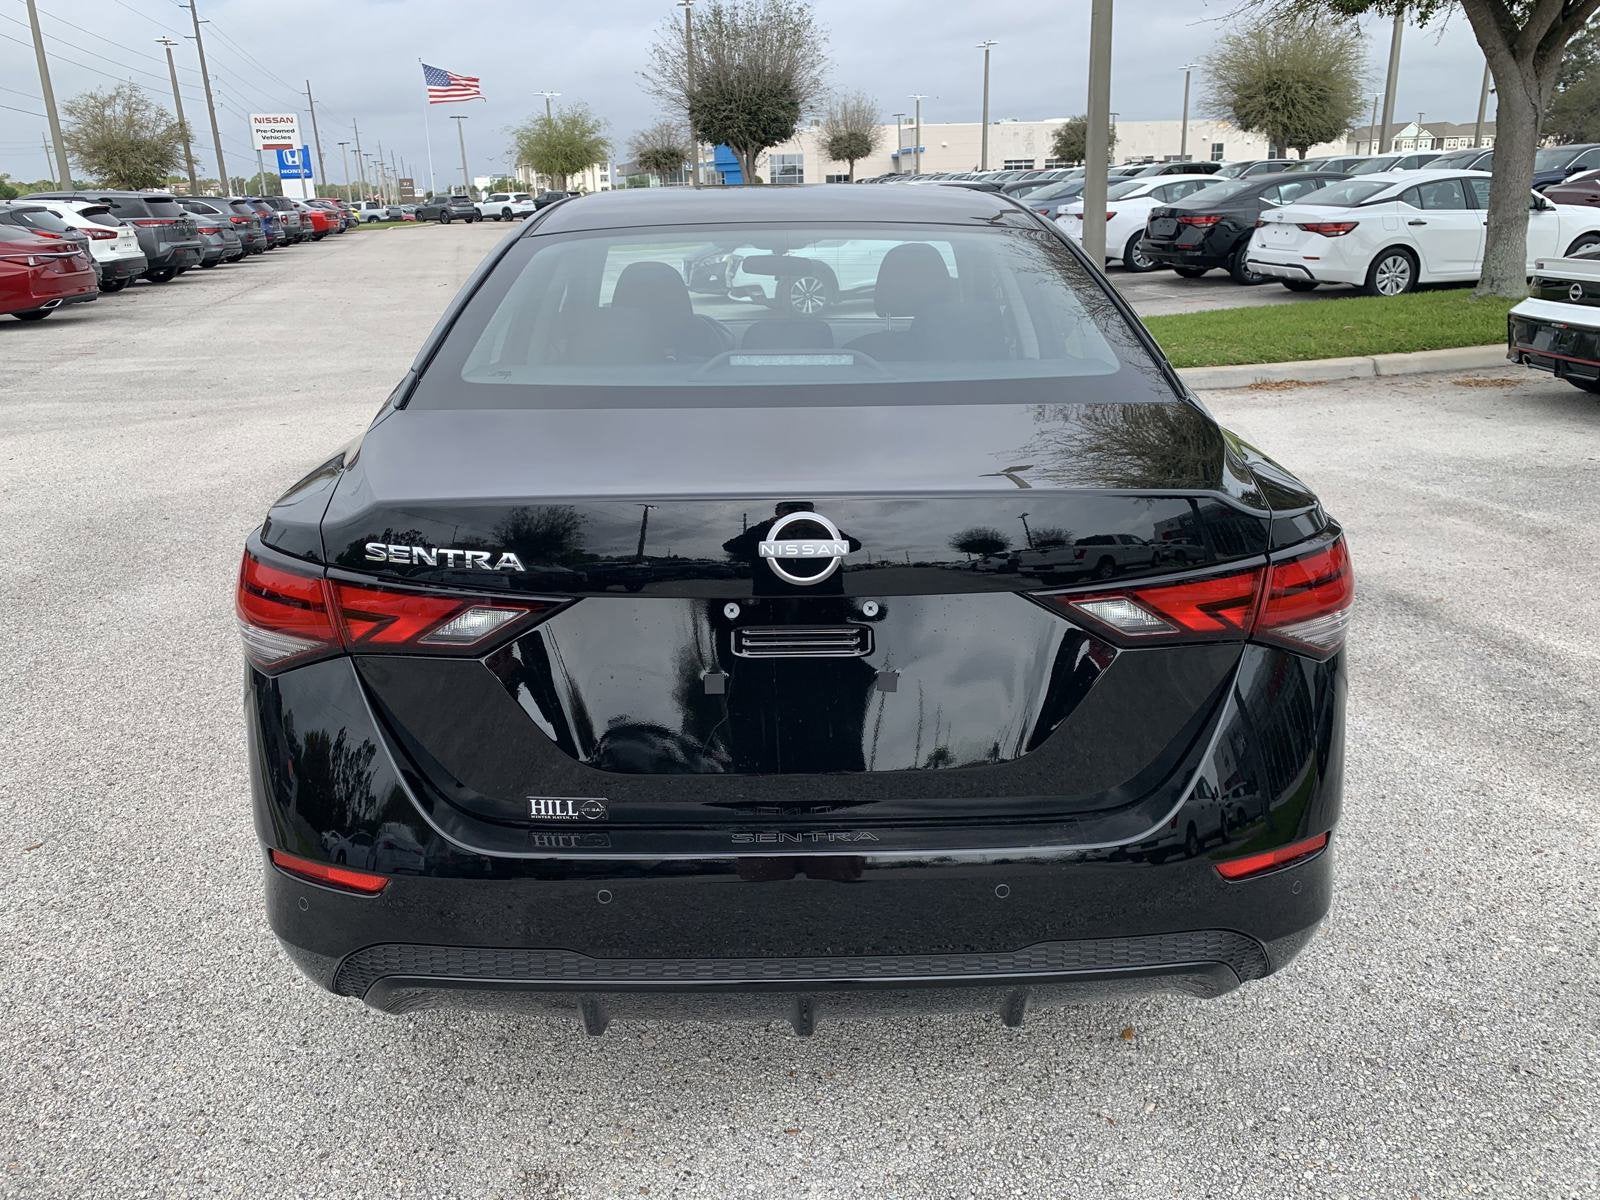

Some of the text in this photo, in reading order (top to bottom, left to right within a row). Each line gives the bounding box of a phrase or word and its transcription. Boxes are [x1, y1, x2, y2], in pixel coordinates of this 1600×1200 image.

[760, 544, 848, 555] NISSAN
[365, 542, 526, 572] SENTRA
[529, 800, 578, 815] HILL
[731, 830, 880, 843] SENTRA
